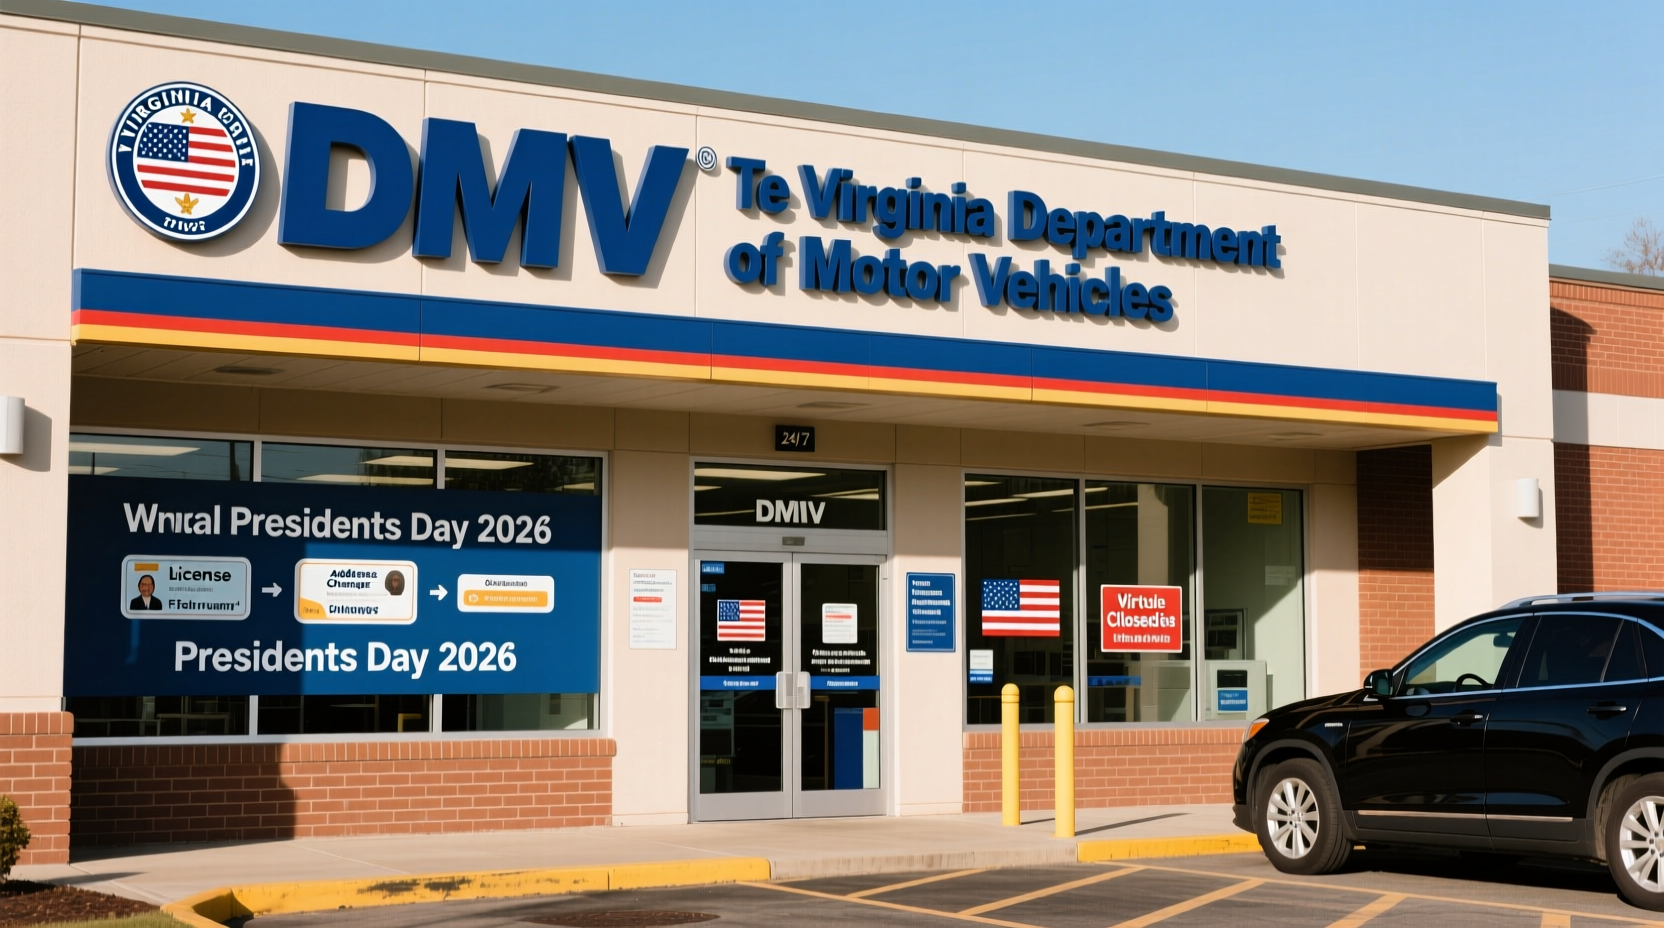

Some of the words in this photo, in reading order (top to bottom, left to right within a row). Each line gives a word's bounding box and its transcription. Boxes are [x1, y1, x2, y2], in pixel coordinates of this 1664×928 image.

[278, 101, 690, 277] DMV
[726, 156, 790, 214] Te
[797, 165, 995, 240] Virginia
[1007, 190, 1282, 269] Department
[724, 232, 784, 286] of
[799, 235, 960, 303] Motor
[968, 252, 1174, 323] Vehicles
[231, 506, 402, 541] Presidents
[411, 511, 469, 549] Day
[477, 514, 552, 544] 2026
[169, 566, 232, 582] License
[174, 640, 358, 672] Presidents
[367, 641, 429, 679] Day
[438, 641, 517, 672] 2026
